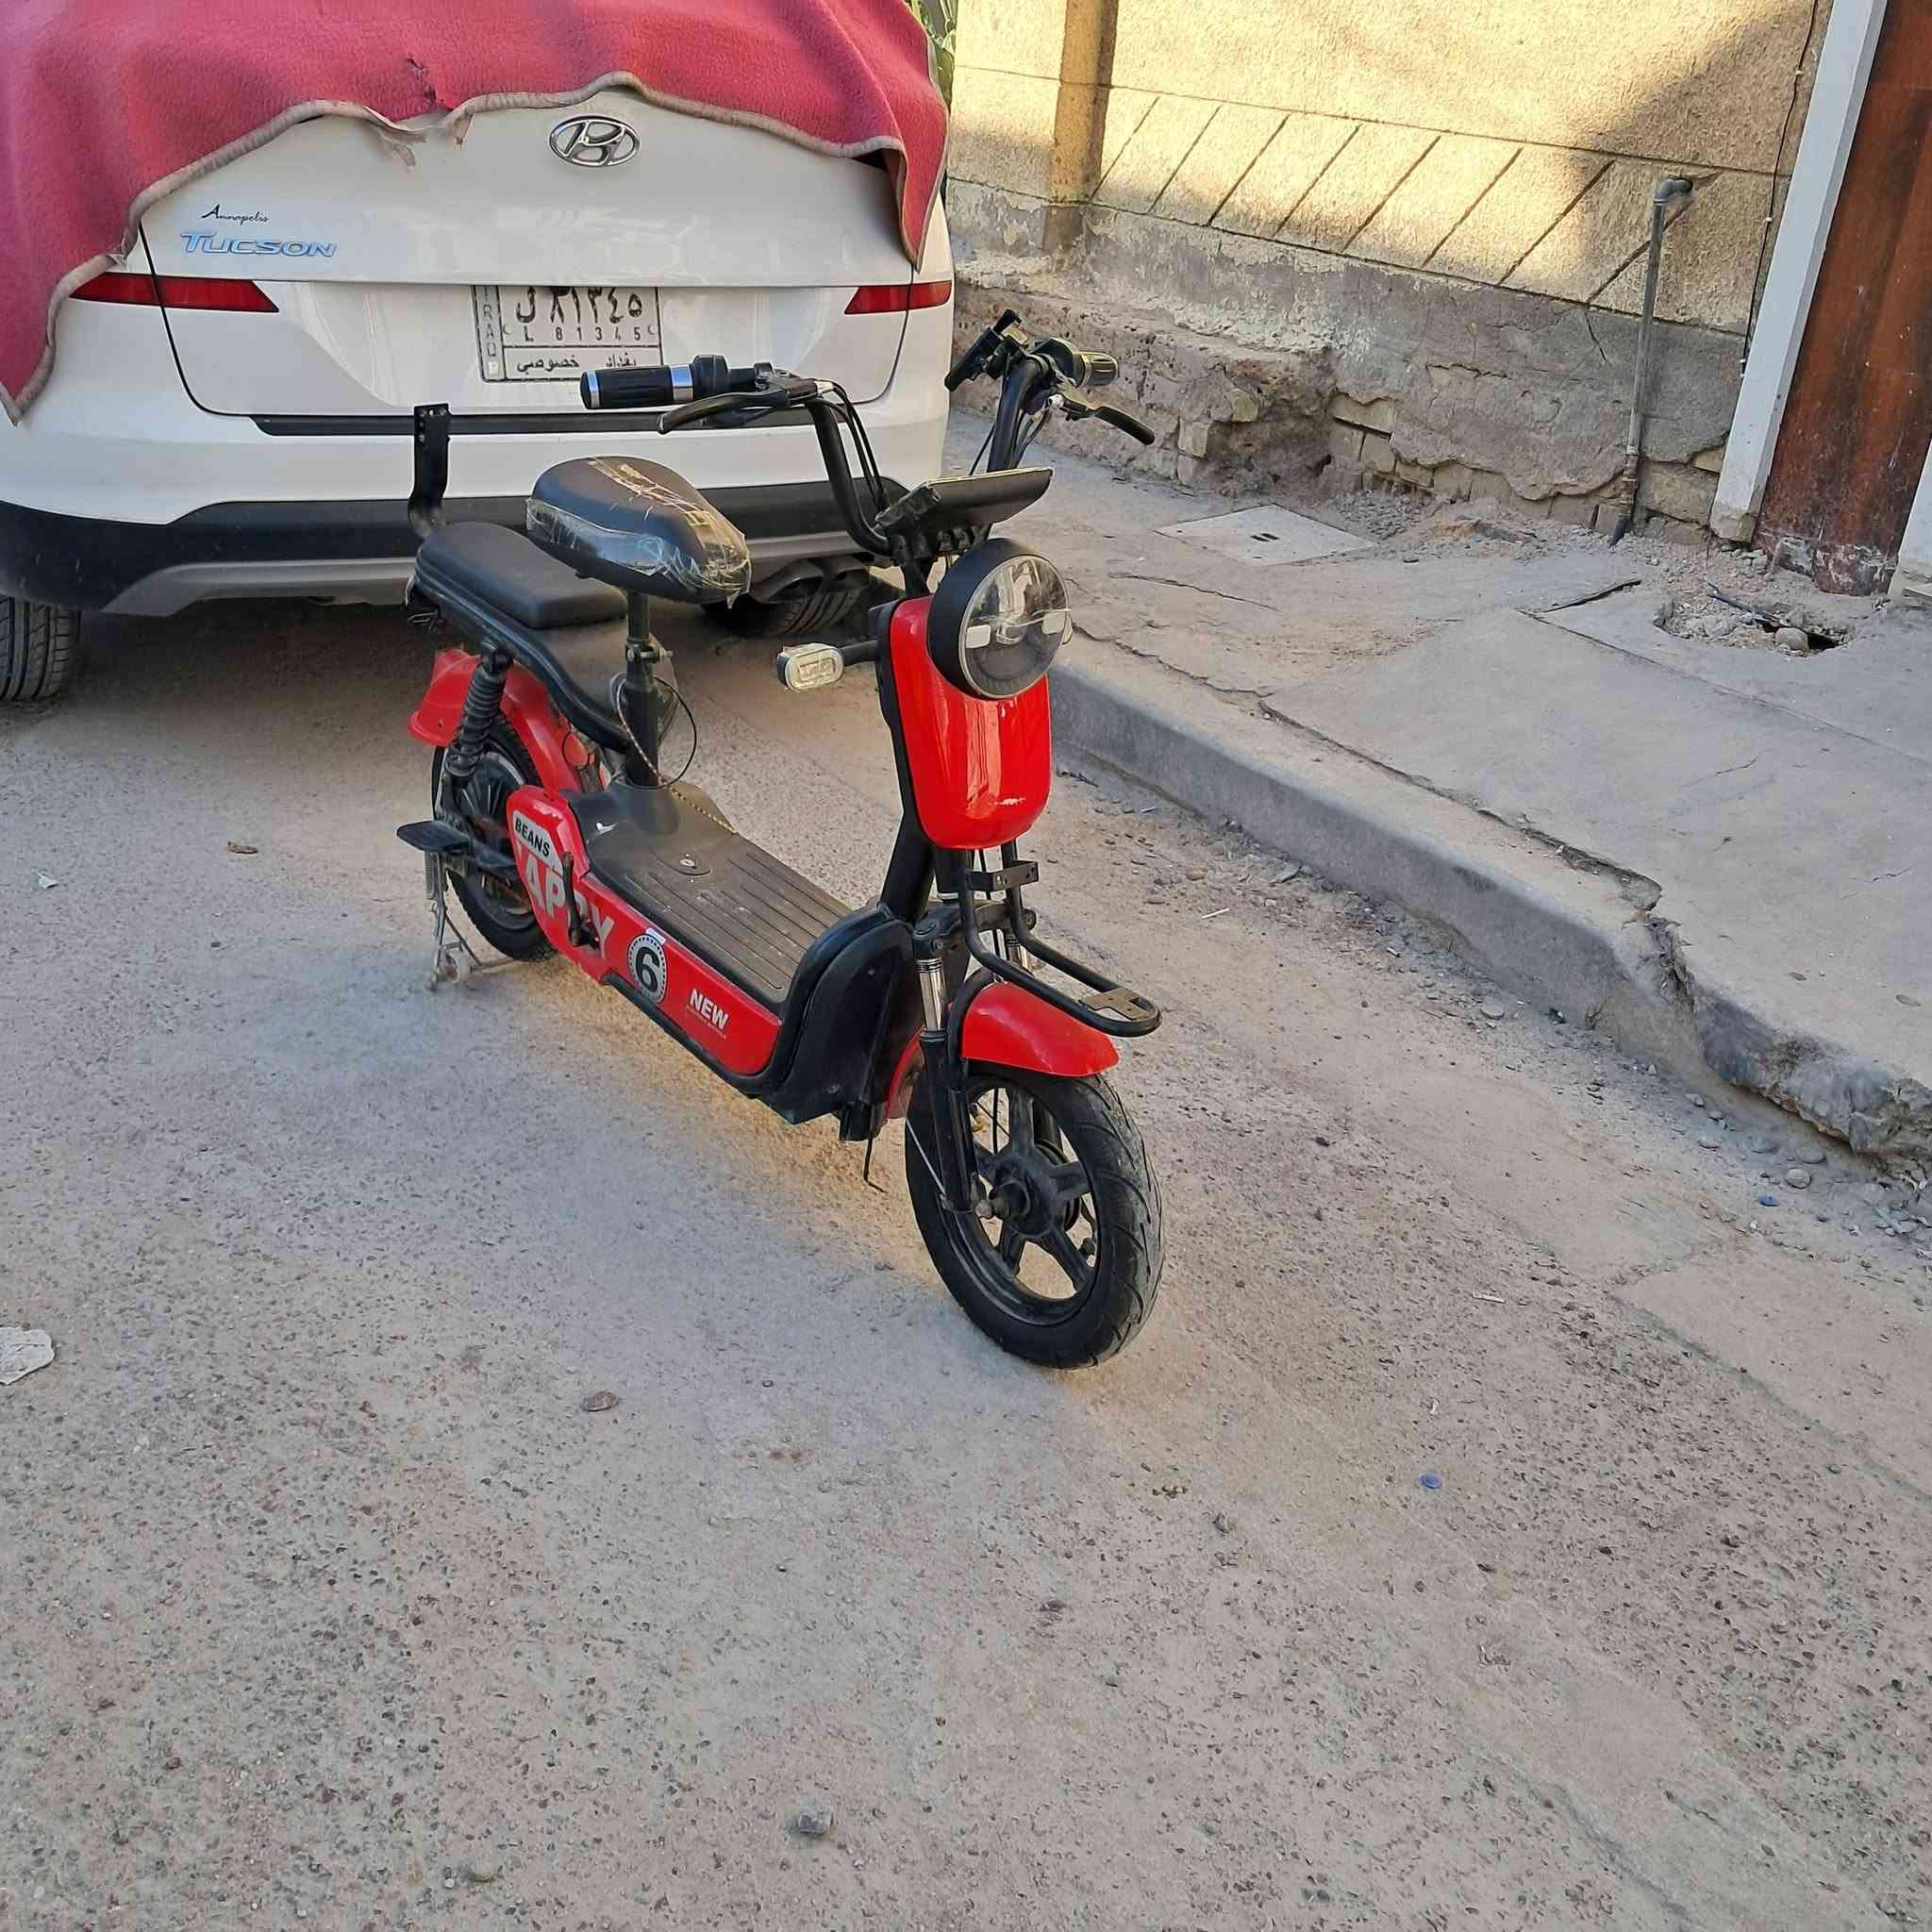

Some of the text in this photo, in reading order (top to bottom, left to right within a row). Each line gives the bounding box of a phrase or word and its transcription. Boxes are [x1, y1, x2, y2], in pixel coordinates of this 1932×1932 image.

[180, 233, 339, 258] TUCSON
[514, 817, 551, 858] BEANS
[635, 946, 660, 992] 6
[689, 988, 730, 1030] NEW
